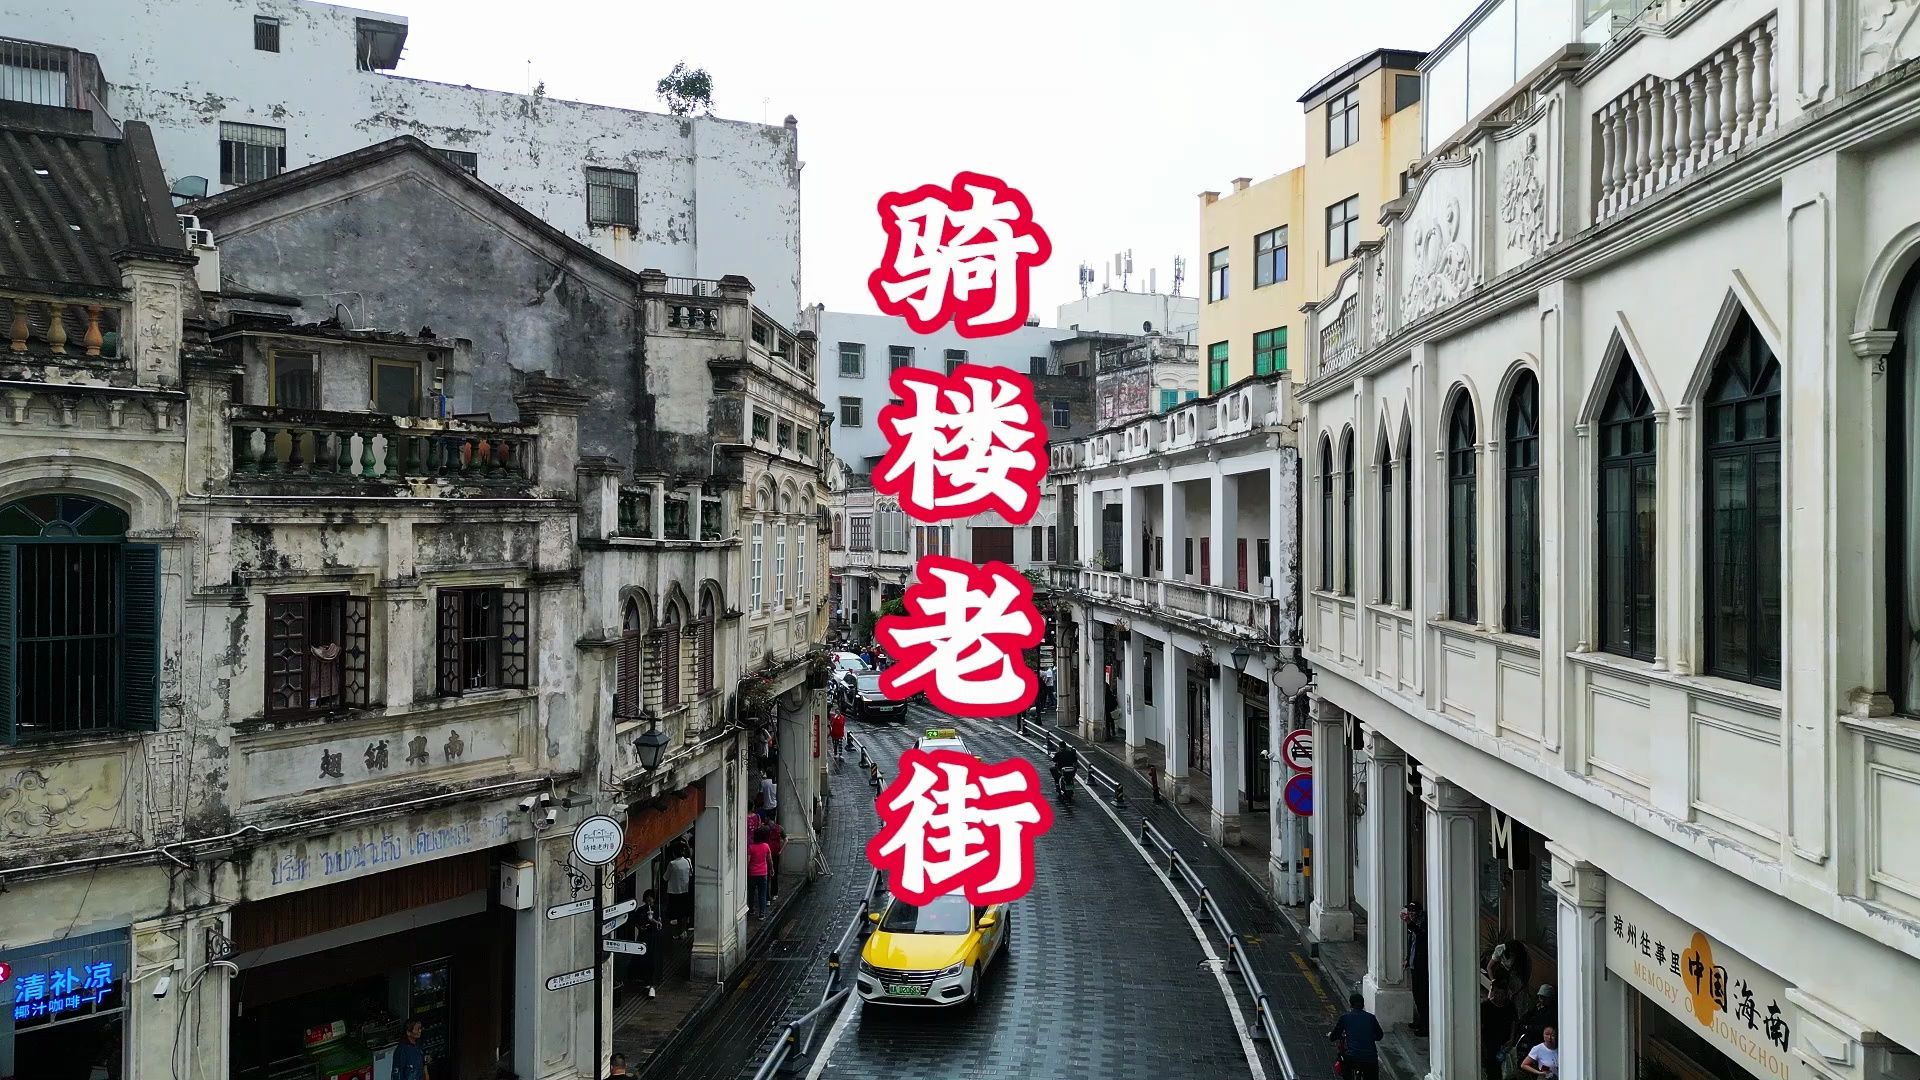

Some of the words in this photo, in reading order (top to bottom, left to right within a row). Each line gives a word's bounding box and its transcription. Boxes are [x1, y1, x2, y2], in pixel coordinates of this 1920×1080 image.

[1613, 914, 1682, 978] 琼州往事里
[14, 988, 112, 1020] 椰汁咖啡一厂
[15, 962, 113, 1003] 清补凉
[1633, 960, 1679, 1004] MEMORY
[1687, 950, 1791, 1053] 中国海南
